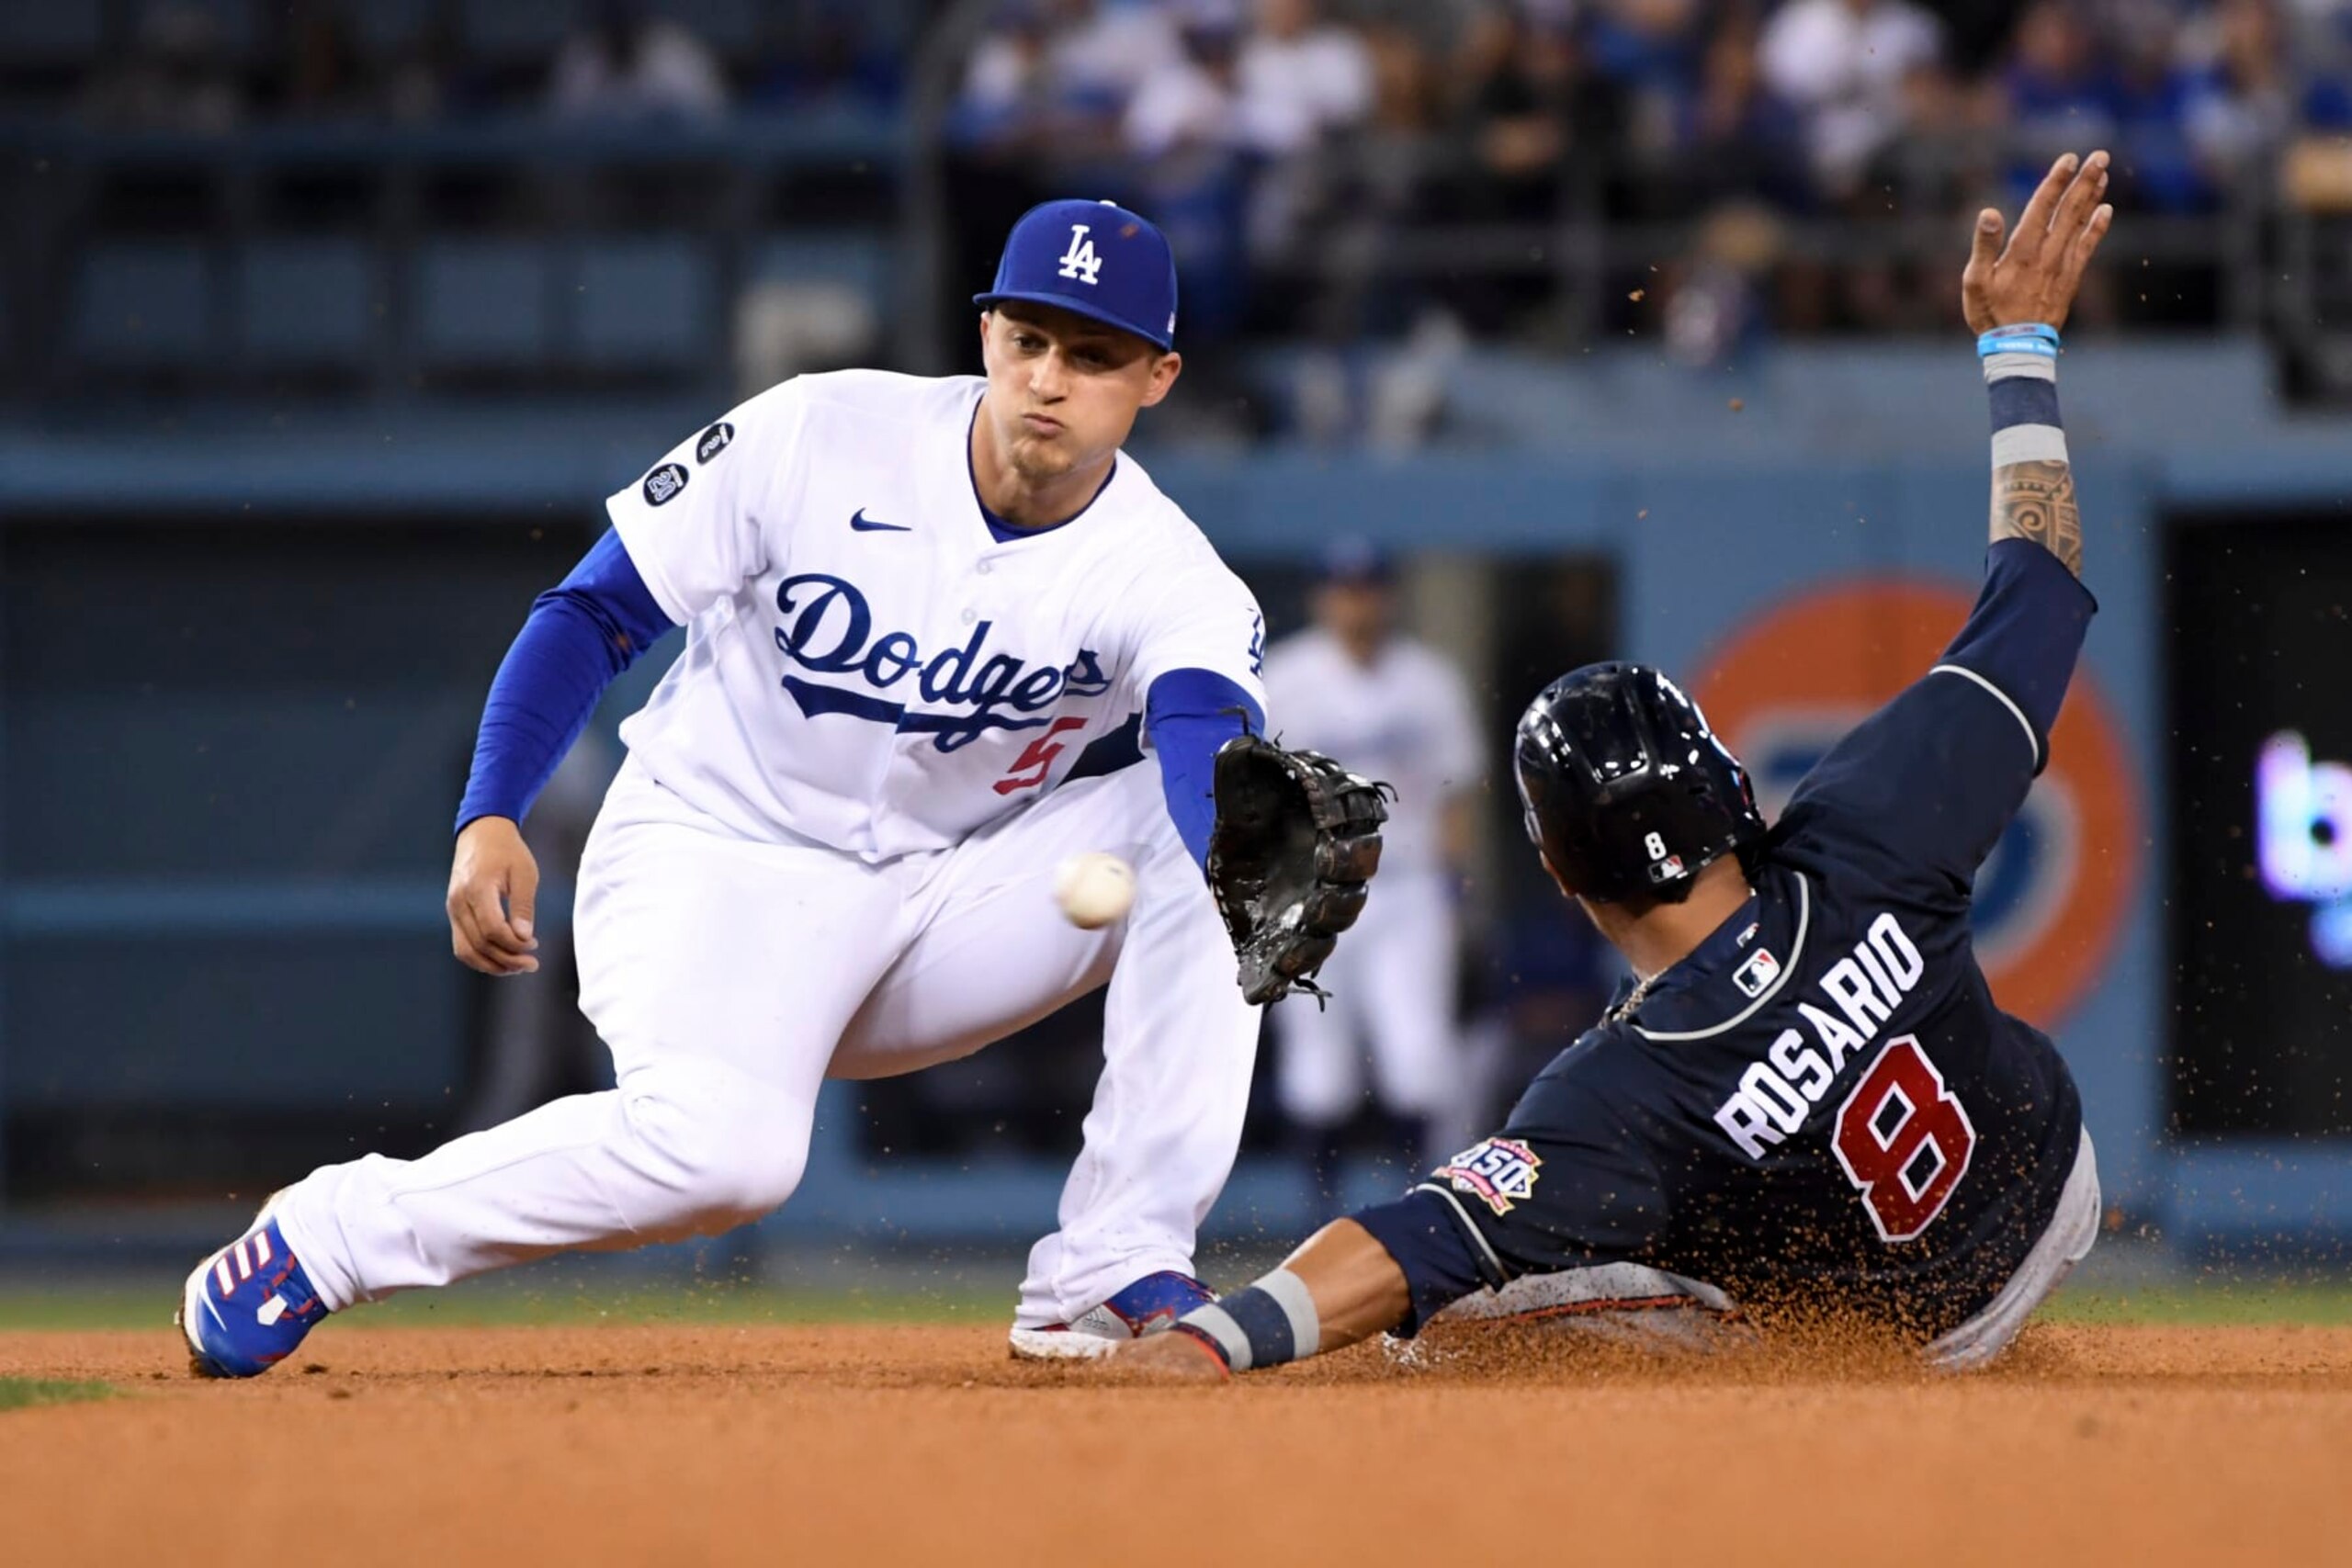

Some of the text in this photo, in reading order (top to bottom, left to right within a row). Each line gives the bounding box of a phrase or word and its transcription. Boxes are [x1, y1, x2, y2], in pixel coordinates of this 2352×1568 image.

[1058, 224, 1102, 285] LA
[647, 470, 677, 502] 20
[775, 573, 1114, 753] Dodges
[992, 716, 1089, 795] 5
[1645, 831, 1667, 861] 8
[1713, 912, 1924, 1160] ROSARIO
[1830, 1032, 1976, 1241] 8
